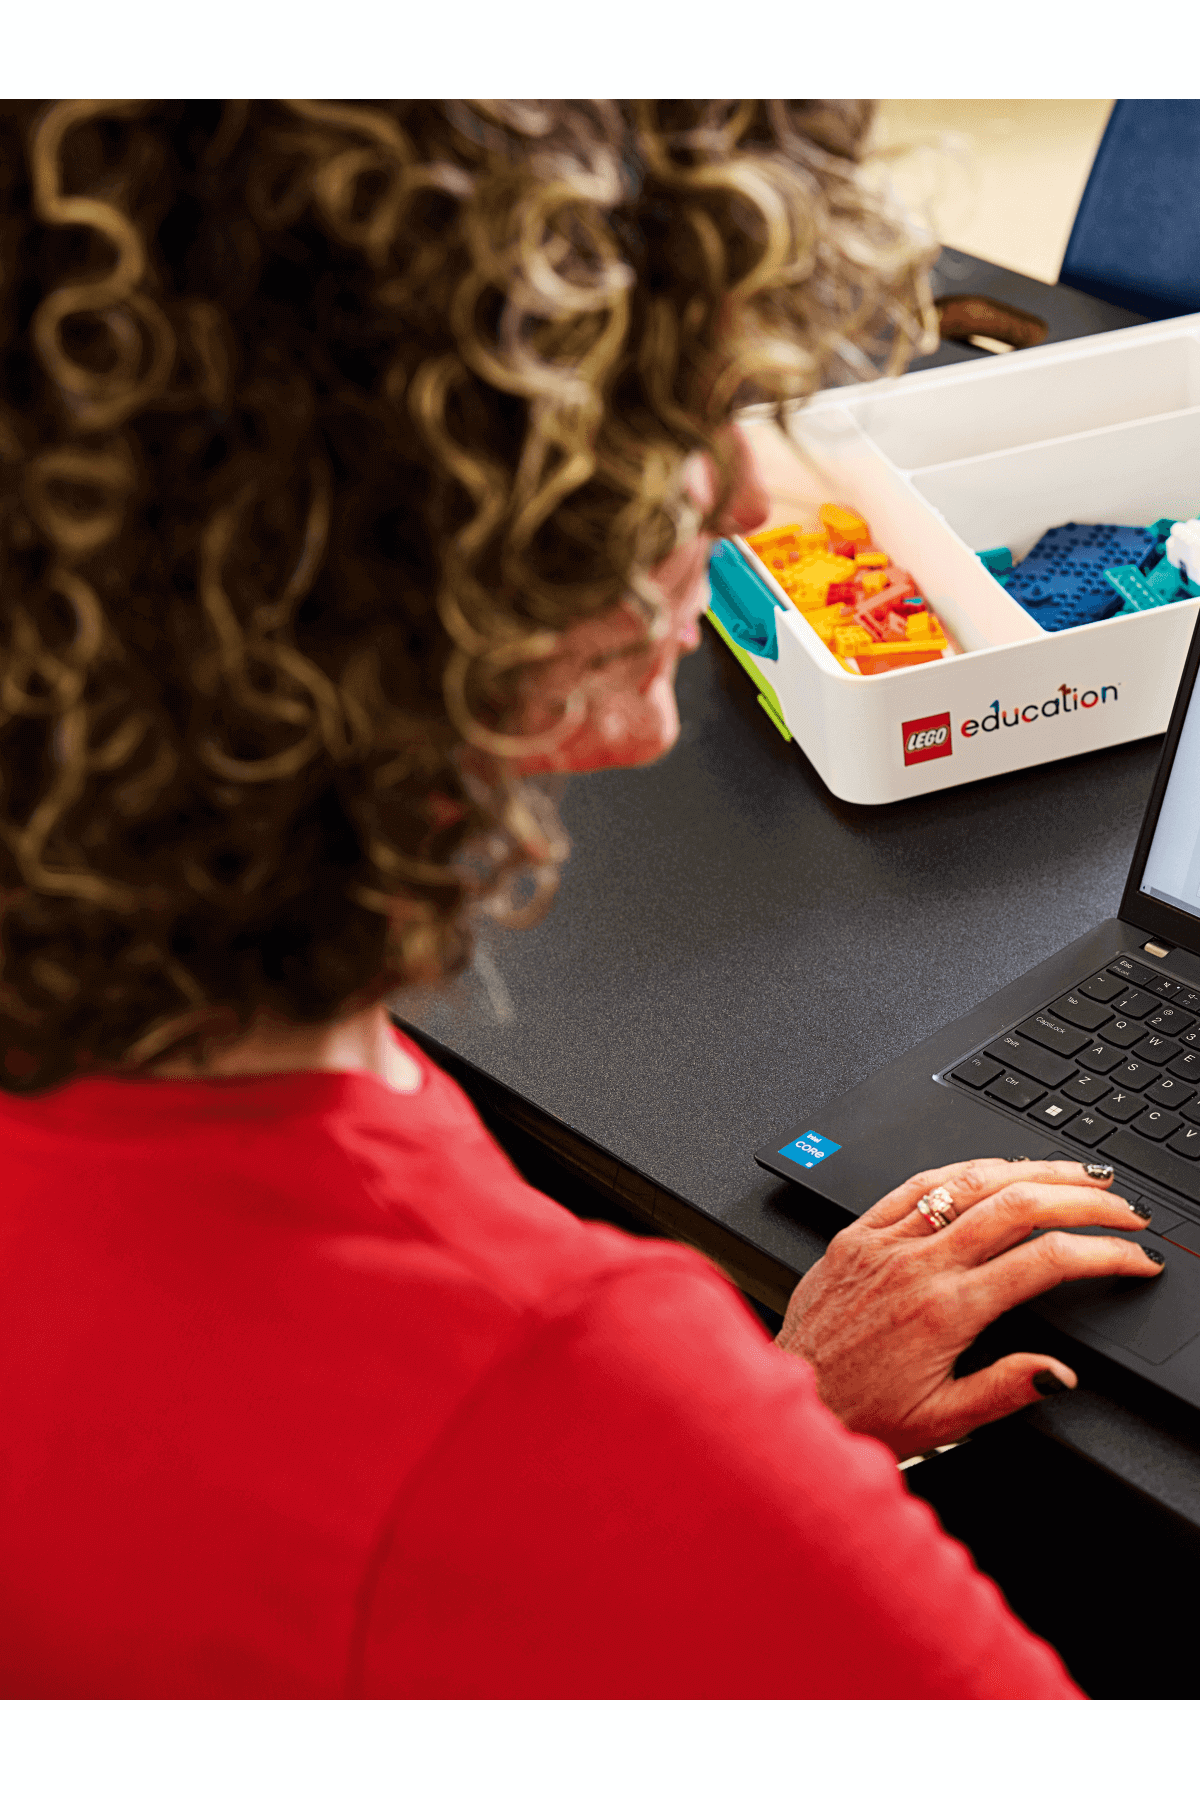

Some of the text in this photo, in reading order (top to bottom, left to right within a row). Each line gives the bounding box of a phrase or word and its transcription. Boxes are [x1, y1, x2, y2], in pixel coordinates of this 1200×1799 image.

[907, 684, 1118, 753] LEGO education
[1036, 1017, 1065, 1033] CapsLock
[1004, 1038, 1019, 1047] Shift
[1150, 1037, 1163, 1045] W
[1006, 1077, 1019, 1085] Ctrl
[1113, 1094, 1125, 1102] X
